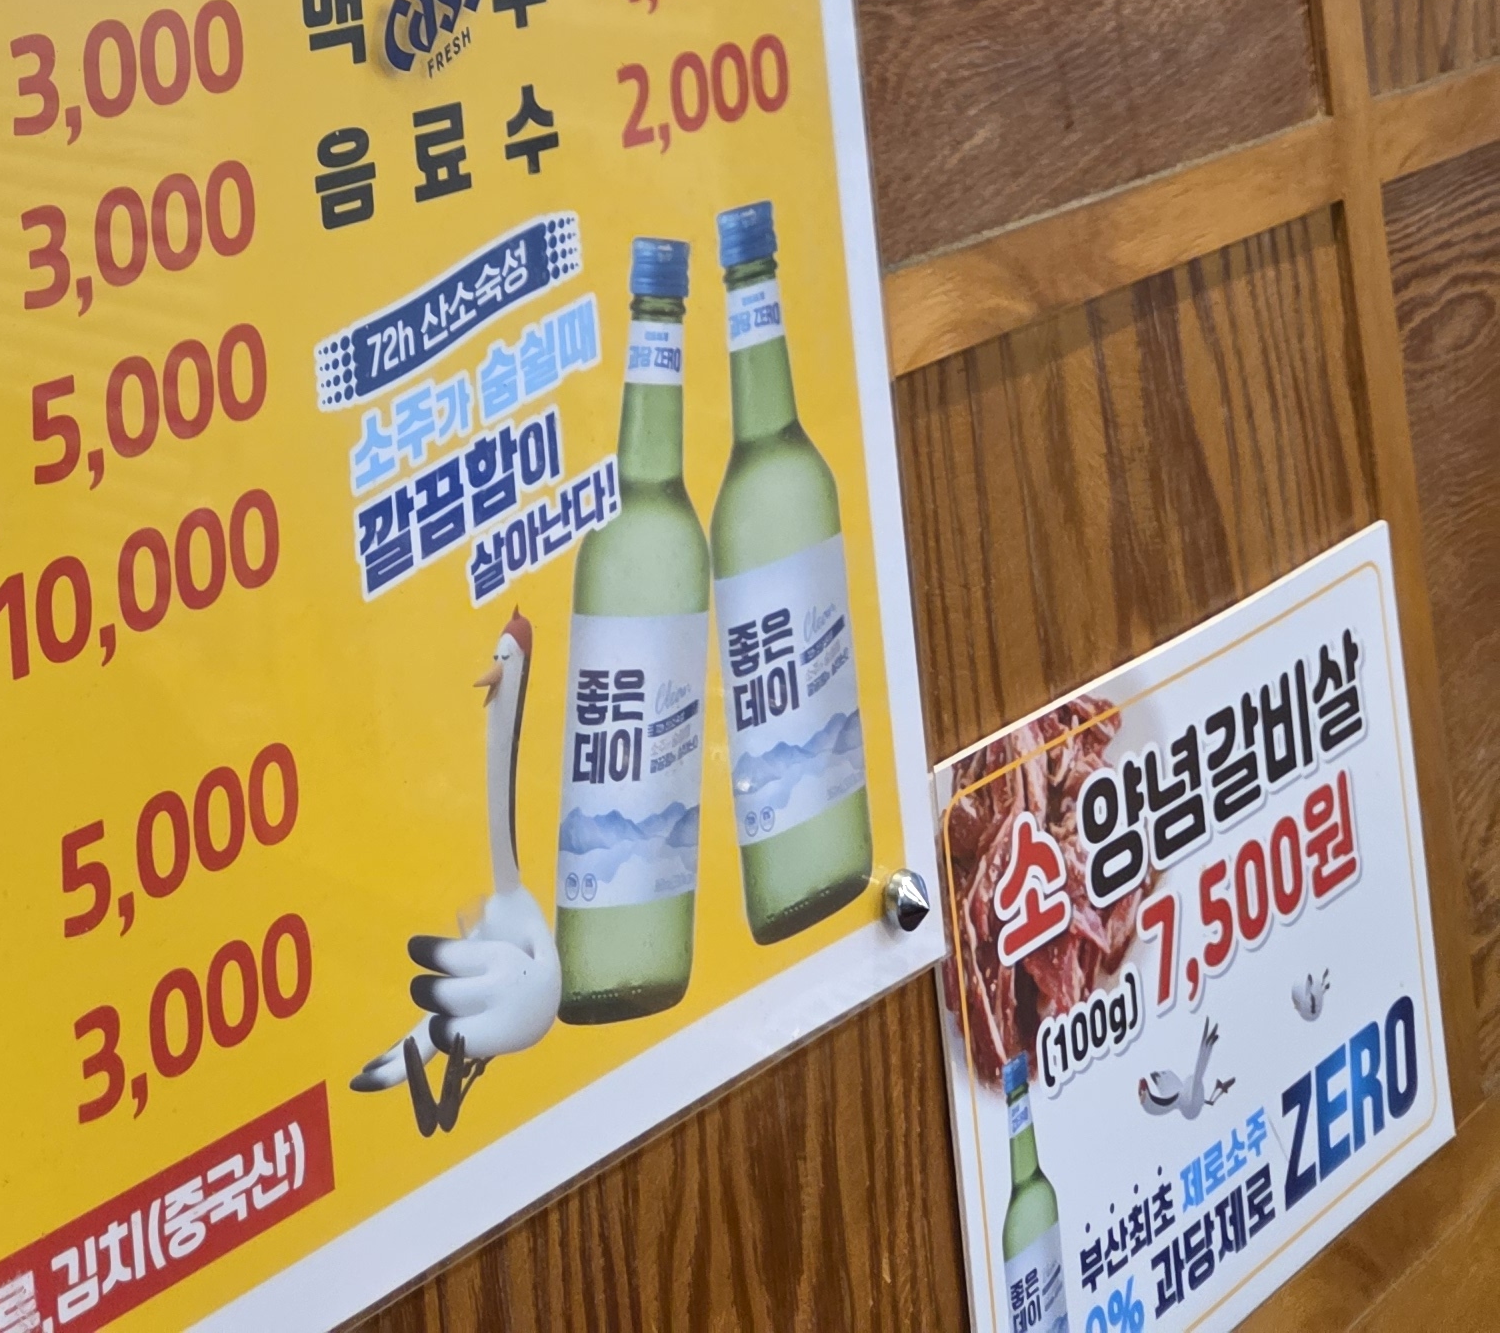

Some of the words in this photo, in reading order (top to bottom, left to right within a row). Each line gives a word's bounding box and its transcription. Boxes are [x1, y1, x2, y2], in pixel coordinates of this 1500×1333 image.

[427, 26, 472, 79] FRESH
[616, 33, 790, 155] 2,000
[20, 158, 256, 317] 3,000
[367, 320, 416, 378] 72h
[420, 240, 529, 350] 산소숙성
[32, 322, 268, 490] 5,000
[355, 378, 471, 489] 소주가
[480, 298, 598, 422] 숨쉴때
[358, 410, 560, 595] 깔끔함이
[471, 461, 618, 601] 살아난다!
[577, 668, 645, 726] 좋은
[728, 608, 794, 678] 좋은
[733, 660, 800, 732] 데이
[572, 727, 643, 784] 데이
[998, 824, 1066, 956] 소
[1082, 629, 1364, 898] 양념갈비살
[61, 742, 299, 938] 5,000
[1141, 771, 1357, 1005] 7,500원
[73, 912, 313, 1125] 3,000
[1042, 972, 1139, 1087] (100g)
[1080, 1181, 1176, 1293] 부산최초
[1180, 1106, 1268, 1213] 제로소주
[1150, 1162, 1276, 1319] 과당제로
[1282, 995, 1418, 1212] ZERO
